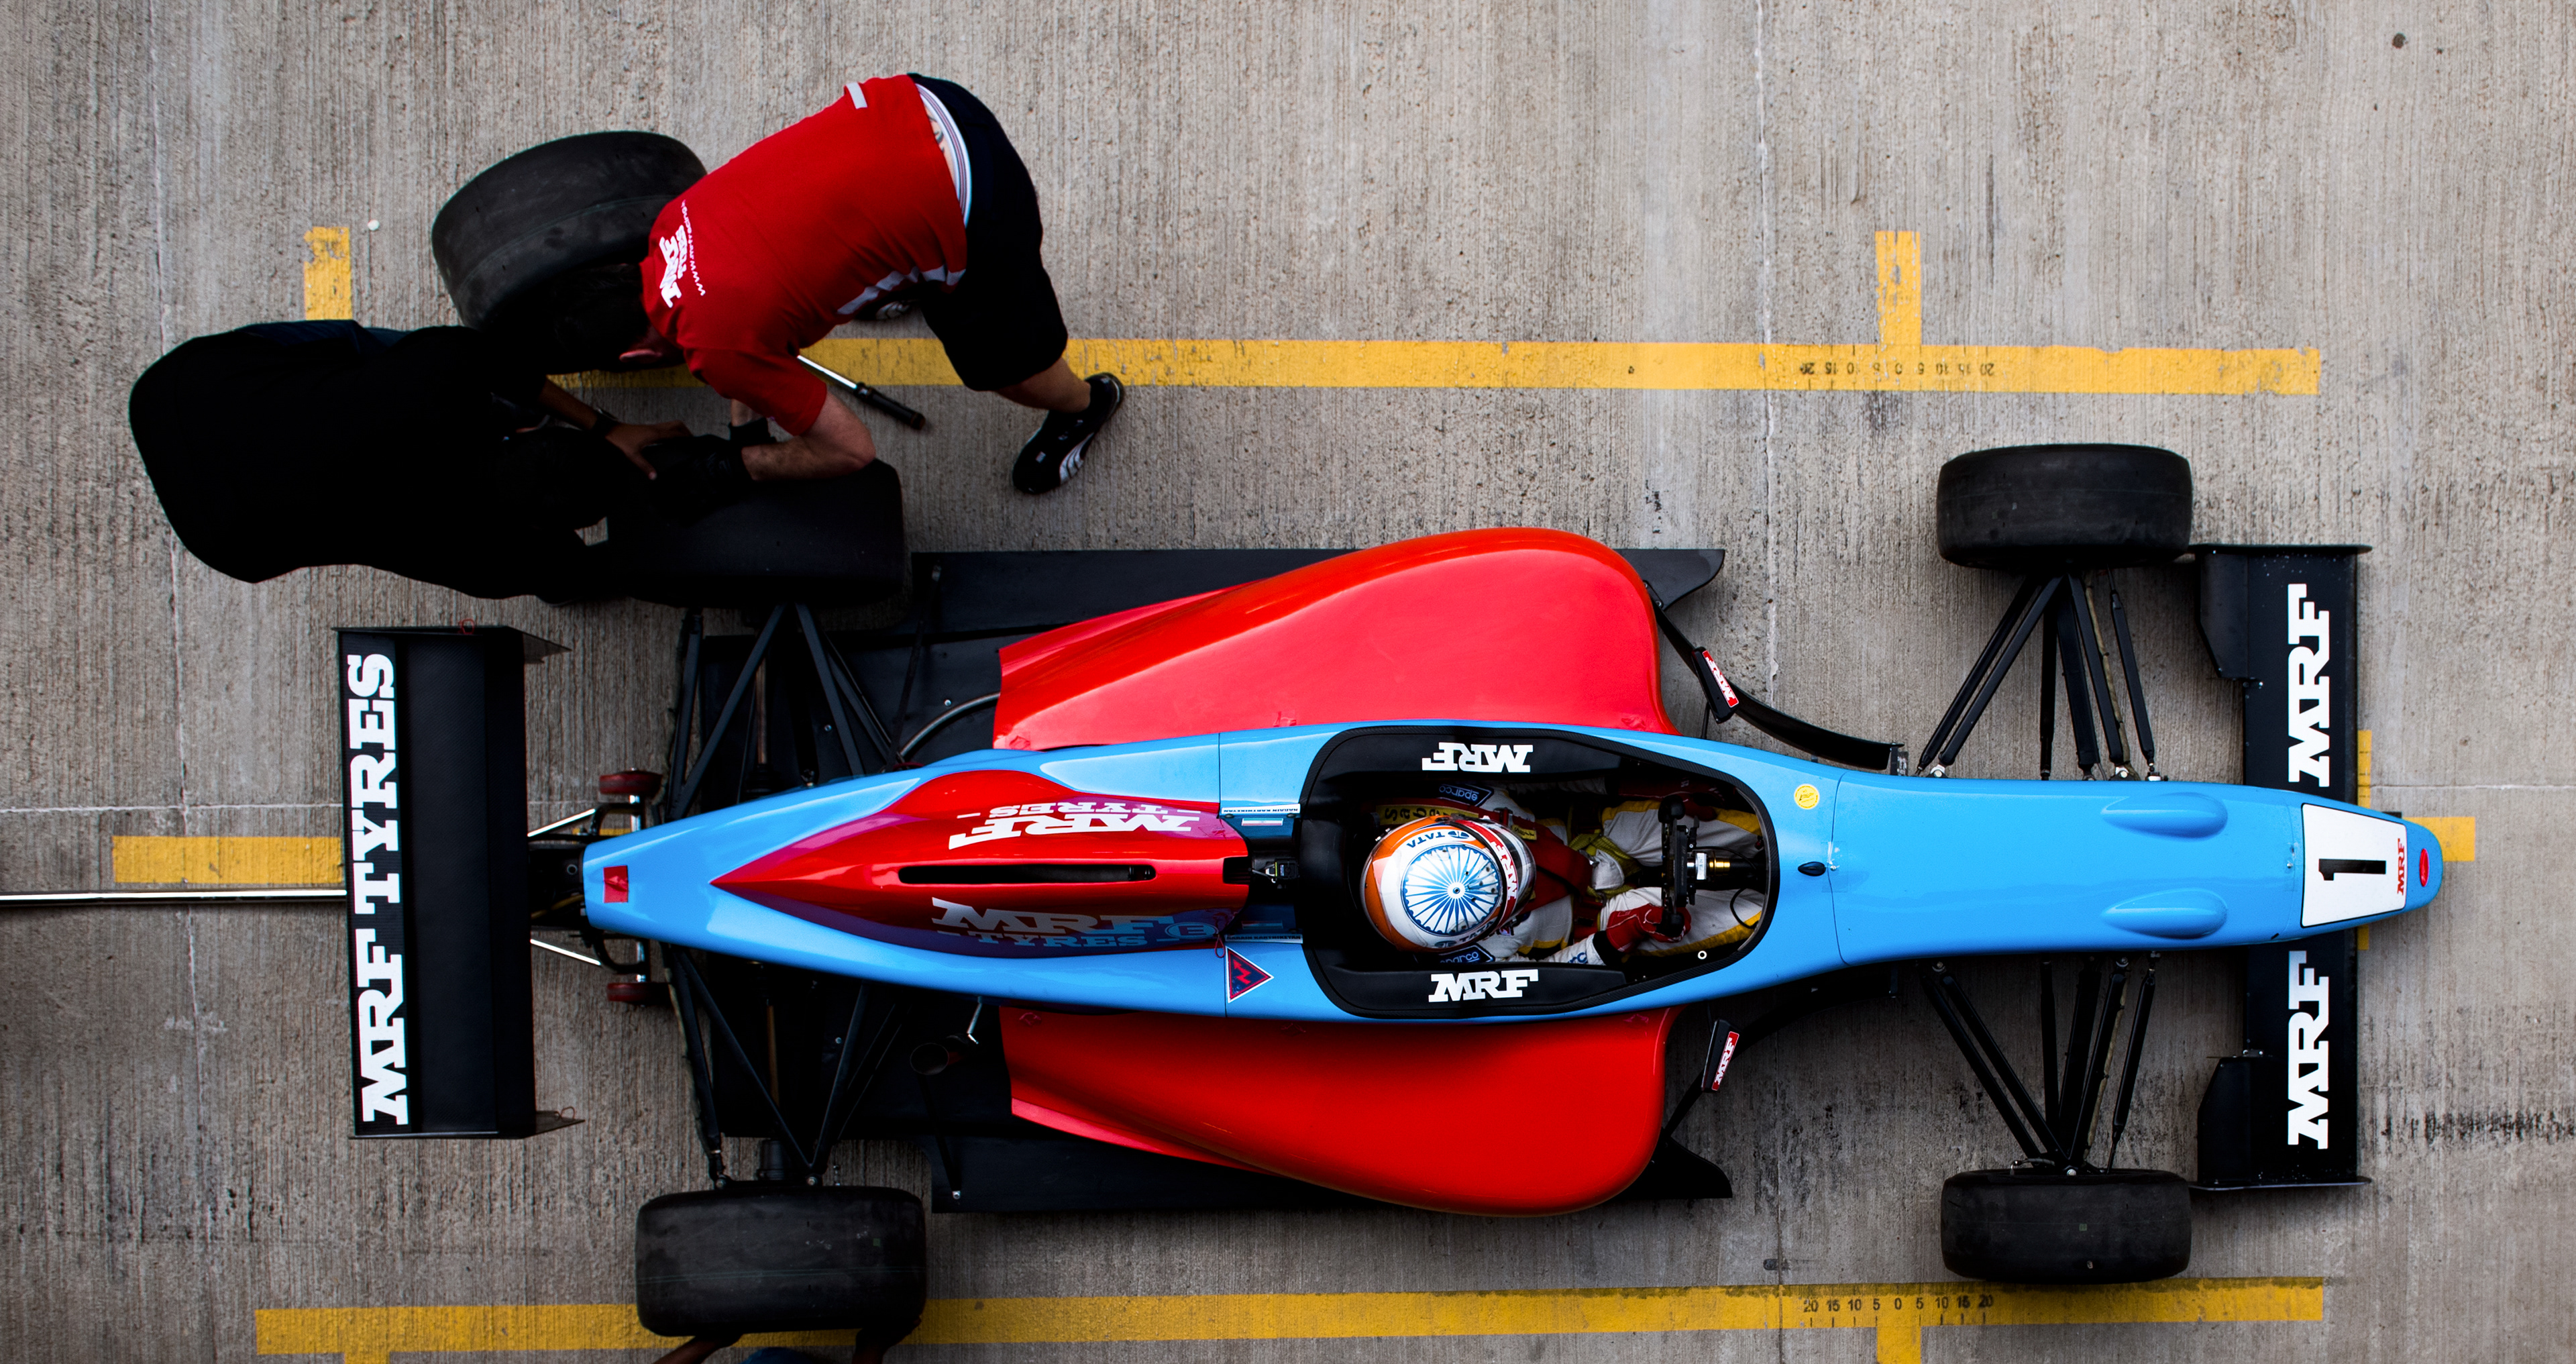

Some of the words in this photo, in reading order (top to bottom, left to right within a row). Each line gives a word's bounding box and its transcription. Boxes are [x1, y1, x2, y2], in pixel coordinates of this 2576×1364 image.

[659, 235, 682, 308] MRF
[1705, 657, 1736, 701] MRF
[2288, 583, 2329, 787] MRF
[1421, 742, 1534, 772] MRF
[346, 653, 400, 914] TYRES
[989, 802, 1169, 818] TYRES
[949, 814, 1201, 849] MRF
[1406, 832, 1446, 848] TATA
[1490, 841, 1517, 900] MRF
[2318, 858, 2386, 881] 1
[2397, 838, 2406, 895] MRF
[932, 896, 1174, 935] MRF
[967, 930, 1148, 947] TYRES
[1428, 969, 1538, 1002] MRF
[355, 929, 409, 1125] MRF
[1714, 1037, 1734, 1085] MRF
[2288, 950, 2328, 1149] MRF
[1827, 1299, 1840, 1312] 15
[1847, 1299, 1862, 1311] 10
[1873, 1298, 1880, 1310] 5
[1894, 1298, 1902, 1310] 0
[1916, 1297, 1924, 1309] 5
[1935, 1296, 1949, 1308] 10
